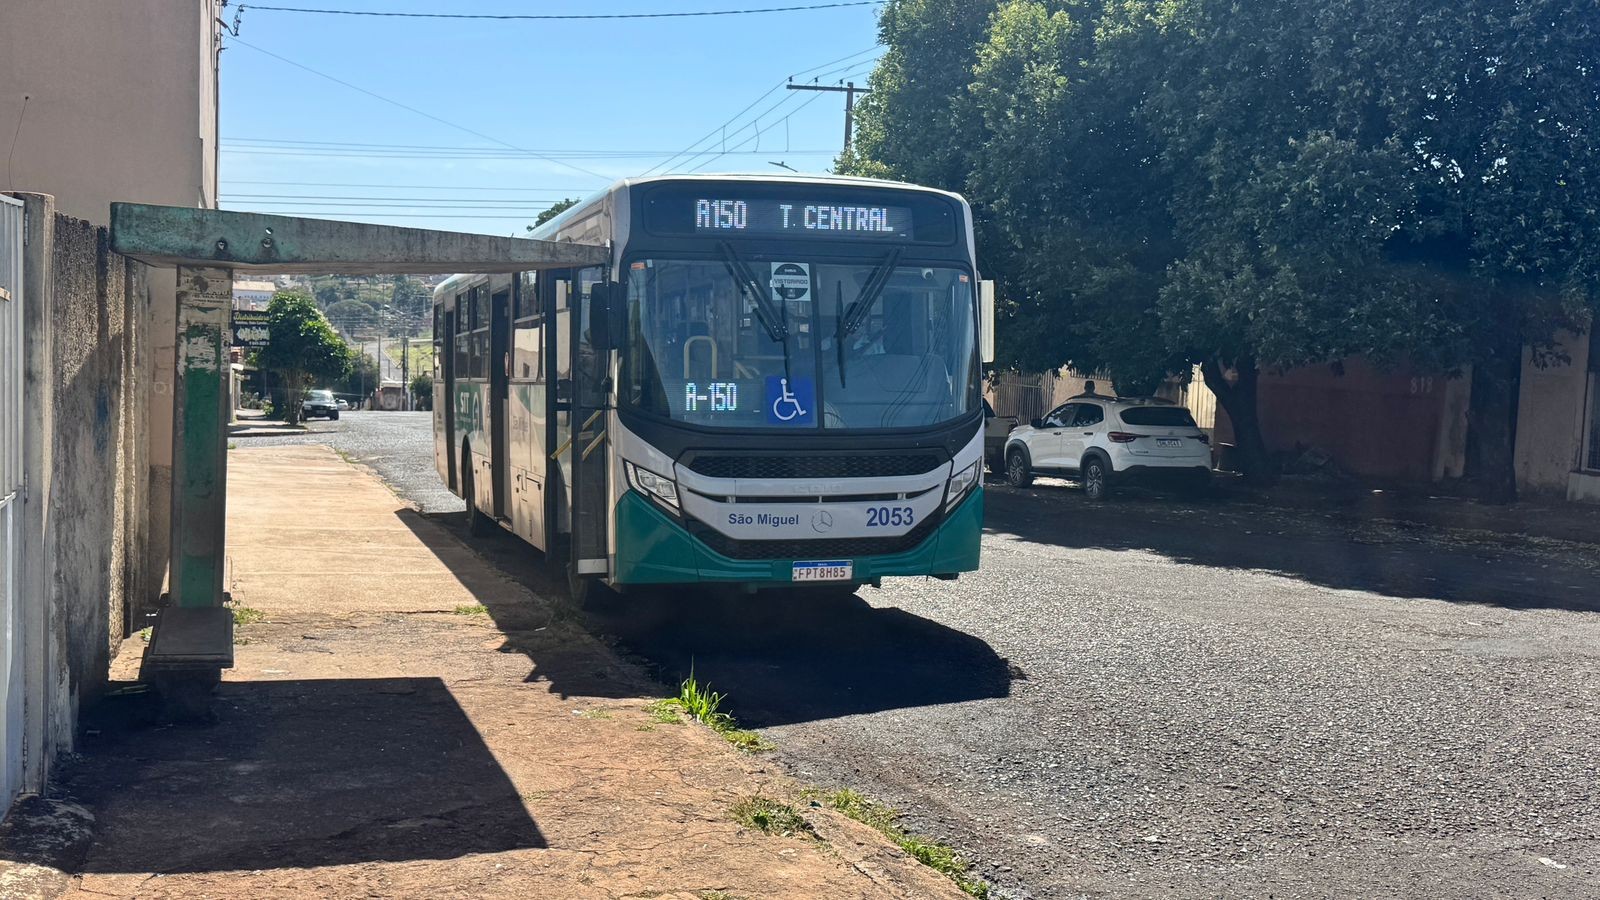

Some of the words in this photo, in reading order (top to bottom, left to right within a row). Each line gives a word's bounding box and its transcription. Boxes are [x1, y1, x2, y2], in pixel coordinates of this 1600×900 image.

[697, 199, 747, 228] A150
[780, 204, 796, 228] T.
[804, 205, 894, 231] CENTRAL
[686, 382, 737, 411] A-150
[728, 513, 753, 525] São
[757, 514, 799, 527] Miguel
[866, 507, 914, 526] 2053
[798, 567, 846, 579] FPT8H85
